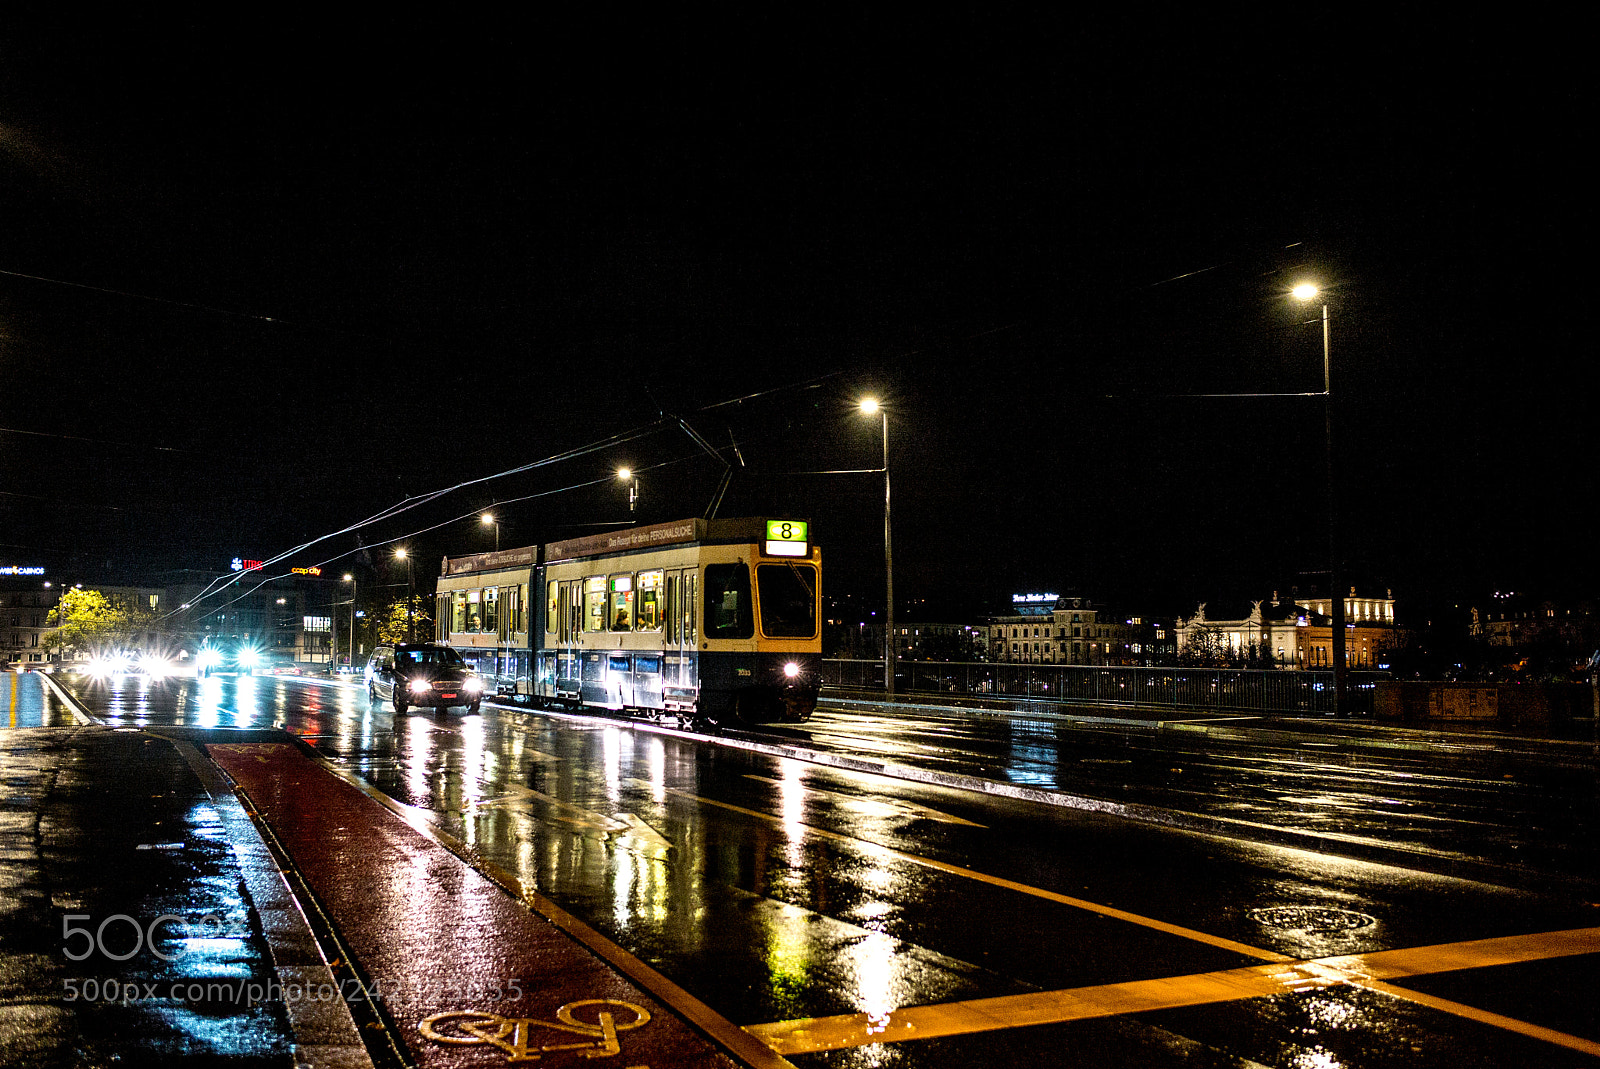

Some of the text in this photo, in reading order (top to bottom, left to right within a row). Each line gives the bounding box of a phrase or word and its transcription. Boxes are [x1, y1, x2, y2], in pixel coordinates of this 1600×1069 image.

[781, 522, 792, 540] 8
[243, 560, 263, 571] UBS
[292, 567, 322, 576] coop city
